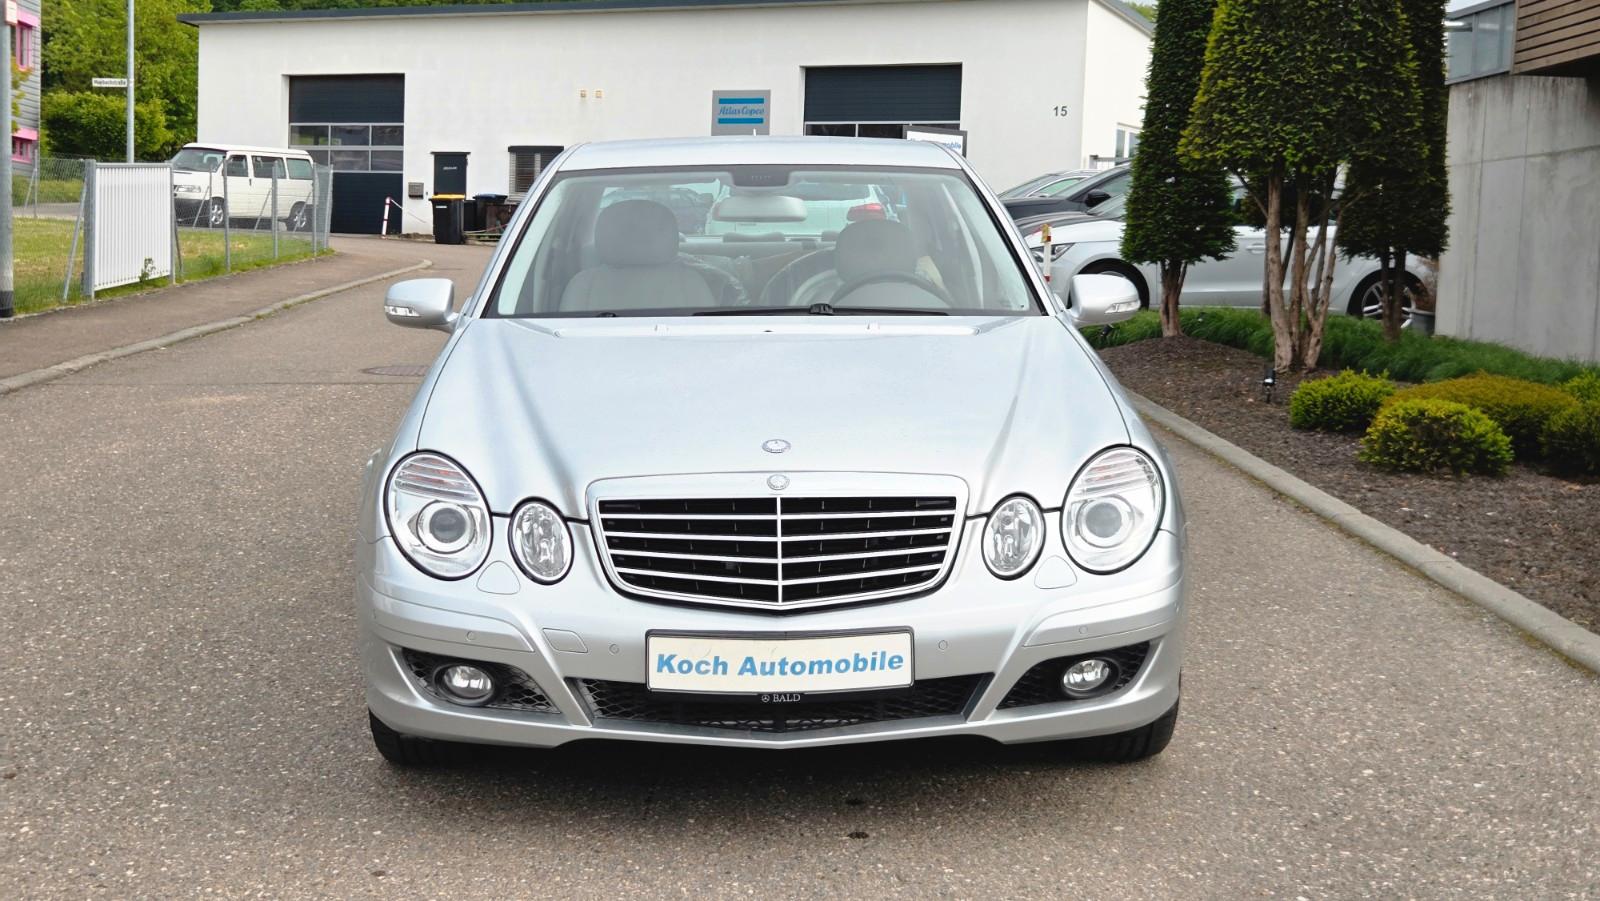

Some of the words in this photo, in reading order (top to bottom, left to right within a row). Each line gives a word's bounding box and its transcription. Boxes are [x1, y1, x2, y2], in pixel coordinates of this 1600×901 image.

[719, 106, 740, 116] Atlas
[1053, 105, 1068, 117] 15
[656, 653, 729, 676] Koch
[737, 651, 904, 676] Automobile
[772, 693, 801, 702] BALD
